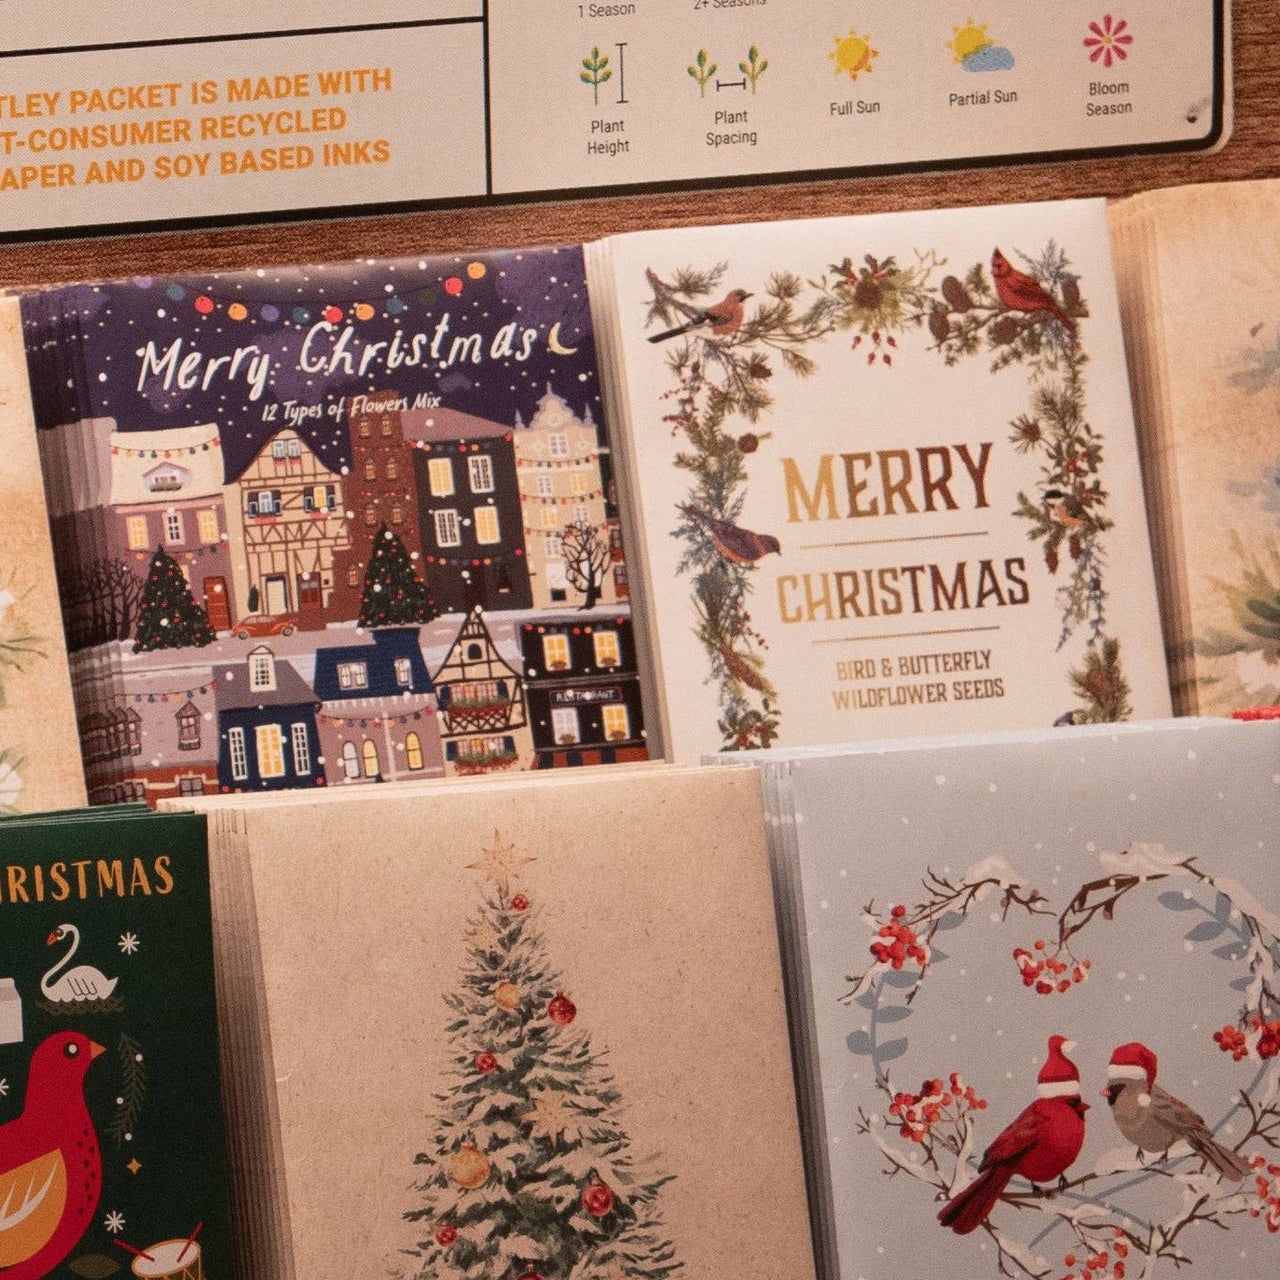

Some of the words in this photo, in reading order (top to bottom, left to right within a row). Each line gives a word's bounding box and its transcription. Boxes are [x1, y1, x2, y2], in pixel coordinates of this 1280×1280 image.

[578, 5, 584, 18] 1
[589, 3, 636, 18] Season
[70, 82, 181, 114] PACKET
[191, 80, 218, 105] IS
[226, 74, 309, 103] MADE
[318, 67, 392, 95] WITH
[949, 90, 991, 107] Partial
[994, 89, 1018, 103] Sun
[1089, 82, 1130, 96] Bloom
[715, 111, 748, 125] Plant
[830, 101, 853, 116] Full
[857, 100, 881, 114] Sun
[1086, 101, 1133, 116] Season
[200, 107, 347, 140] RECYCLED
[591, 120, 624, 134] Plant
[587, 139, 630, 156] Height
[706, 131, 758, 148] Spacing
[84, 158, 145, 185] AND
[154, 153, 211, 180] SOY
[220, 145, 314, 175] BASED
[323, 139, 391, 167] INKS
[136, 337, 269, 401] Merry
[299, 313, 538, 378] Christmas
[262, 403, 279, 421] 12
[283, 400, 322, 427] Types
[327, 396, 346, 423] of
[350, 394, 408, 418] Flowers
[412, 391, 442, 410] Mix
[780, 442, 993, 523] MERRY
[776, 557, 1030, 624] CHRISTMAS
[837, 657, 877, 681] BIRD
[881, 657, 893, 676] &
[899, 649, 992, 677] BUTTERFLY
[832, 682, 948, 710] WILDFLOWER
[952, 678, 1005, 701] SEEDS
